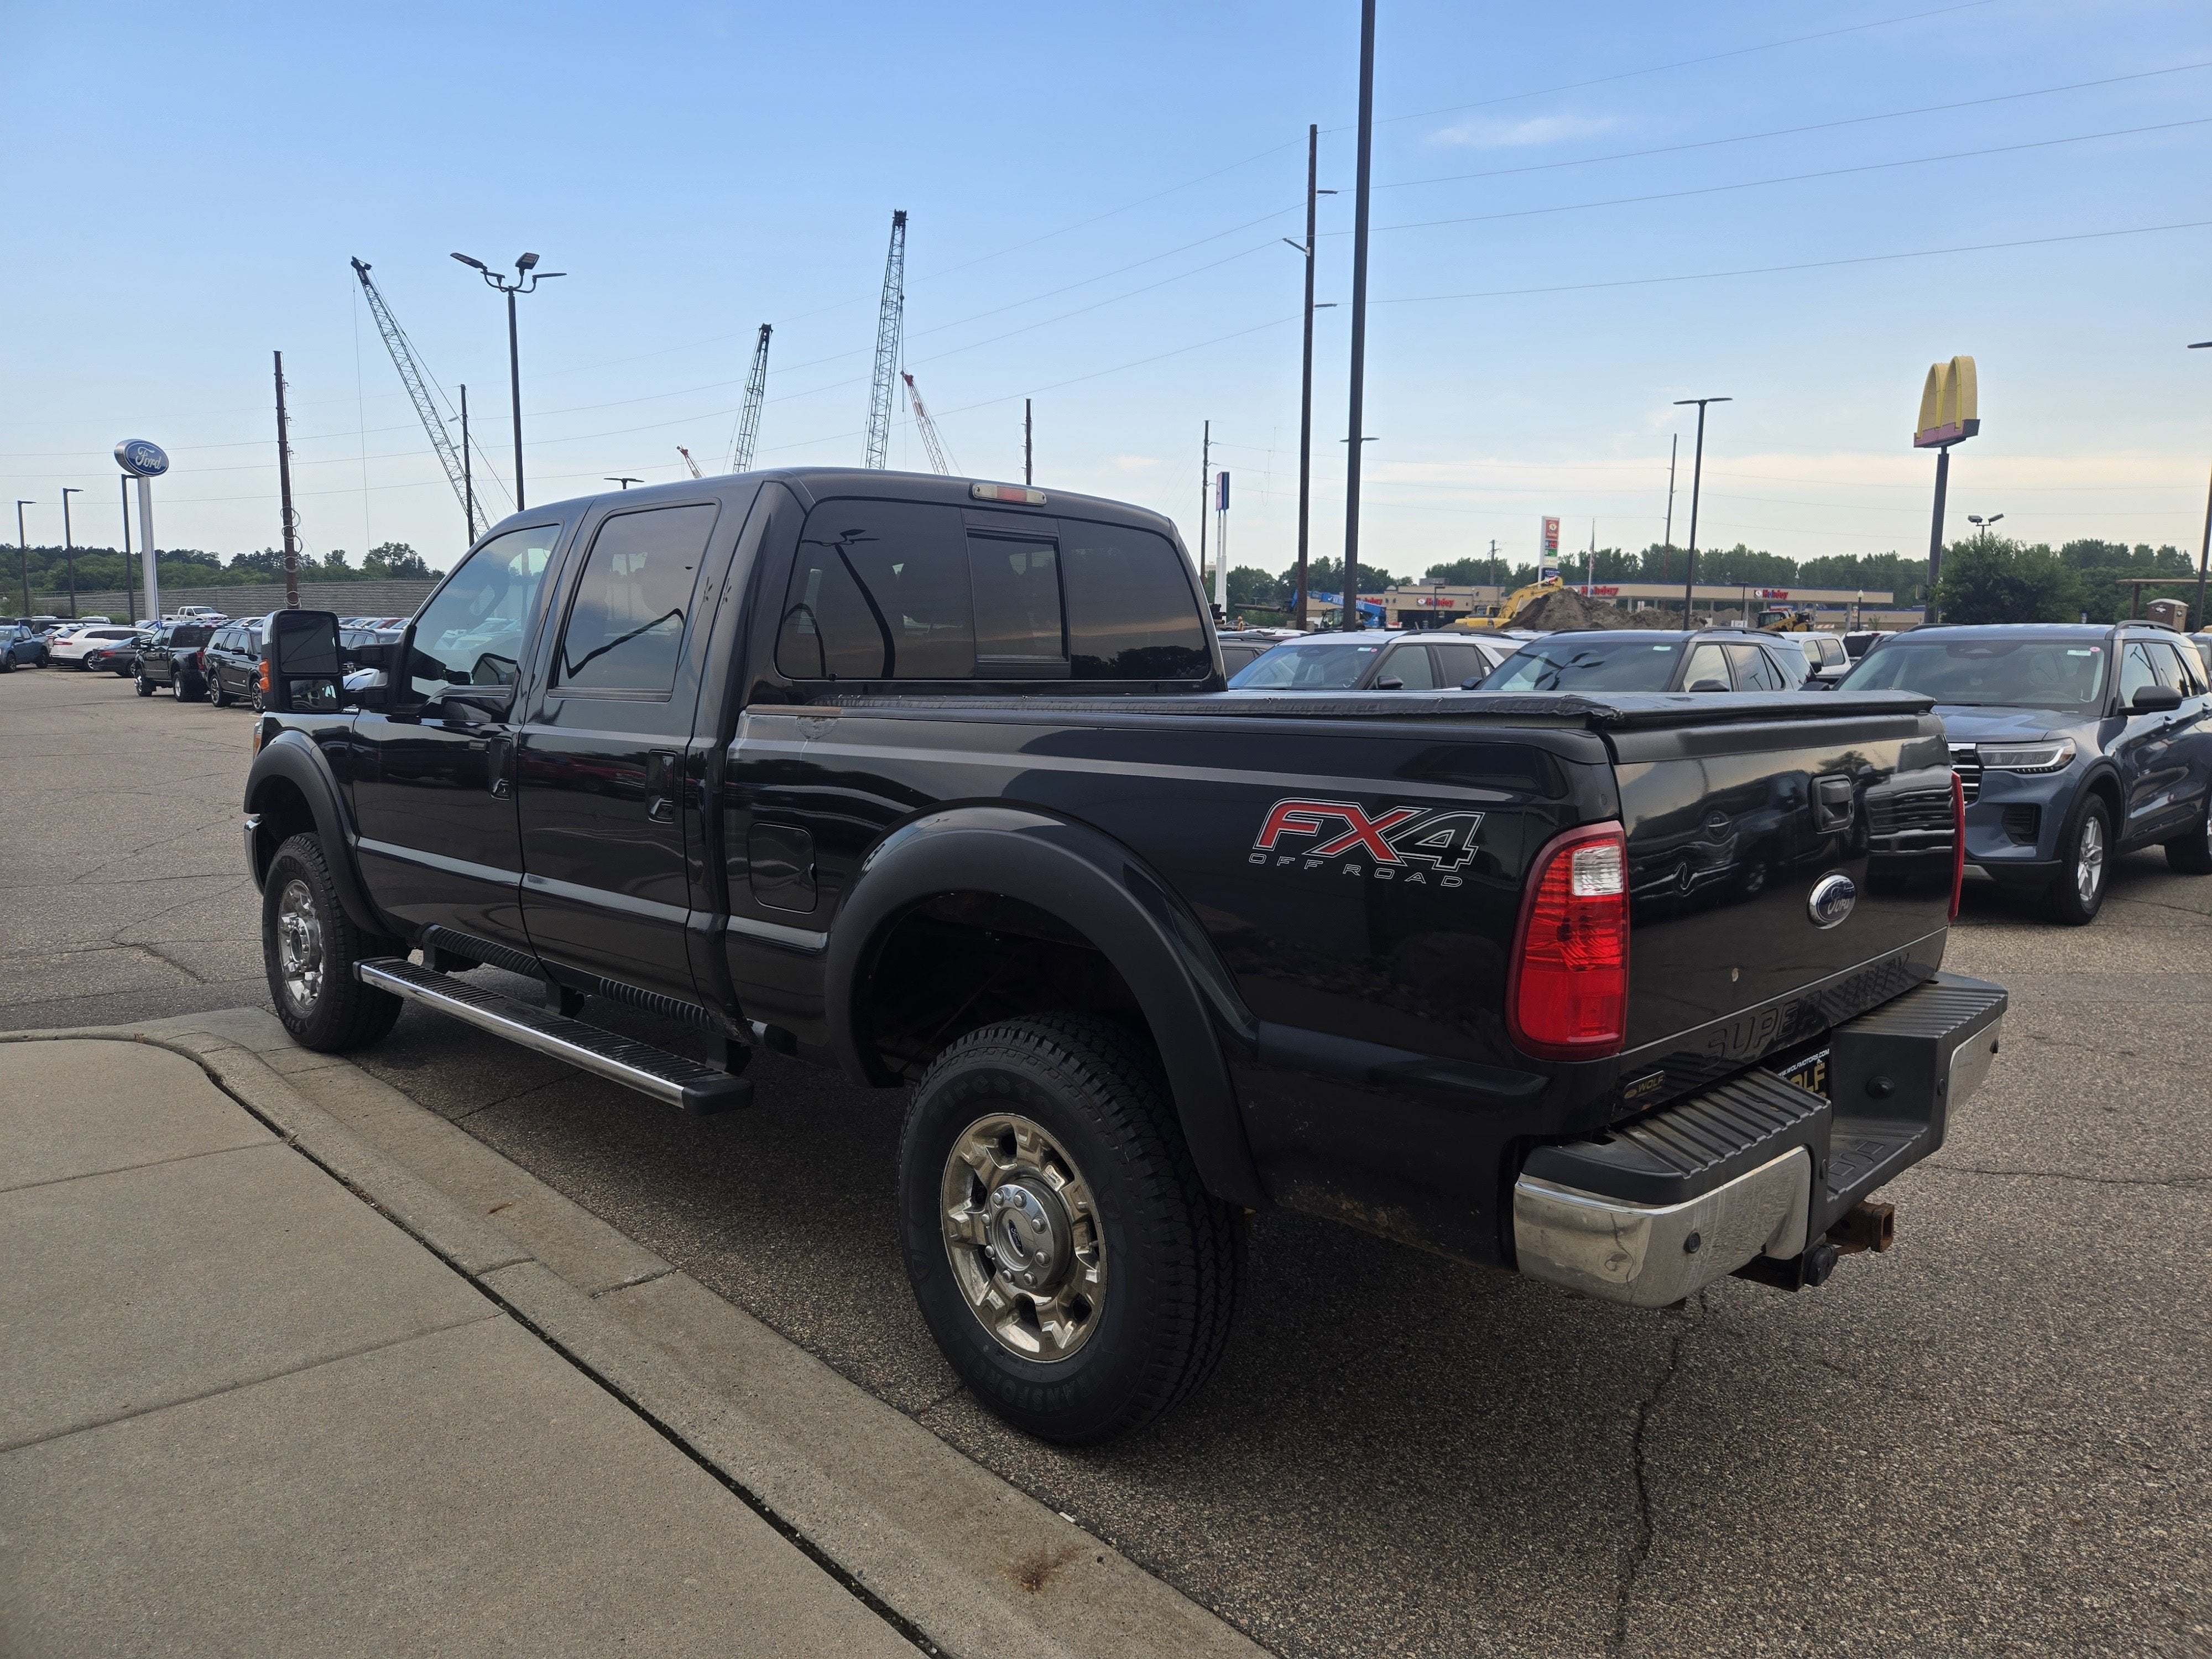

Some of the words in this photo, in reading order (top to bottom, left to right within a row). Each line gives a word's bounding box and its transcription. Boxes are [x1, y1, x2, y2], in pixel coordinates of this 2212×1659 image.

[135, 446, 162, 469] Ford
[1581, 586, 1619, 596] Holiday
[1763, 589, 1788, 599] Holiday
[1252, 797, 1486, 872] FX4
[1248, 853, 1324, 870] OFF
[1342, 864, 1463, 888] ROAD
[1827, 886, 1851, 915] Ford
[1638, 1074, 1665, 1093] WOLF
[1010, 1227, 1022, 1248] Ford
